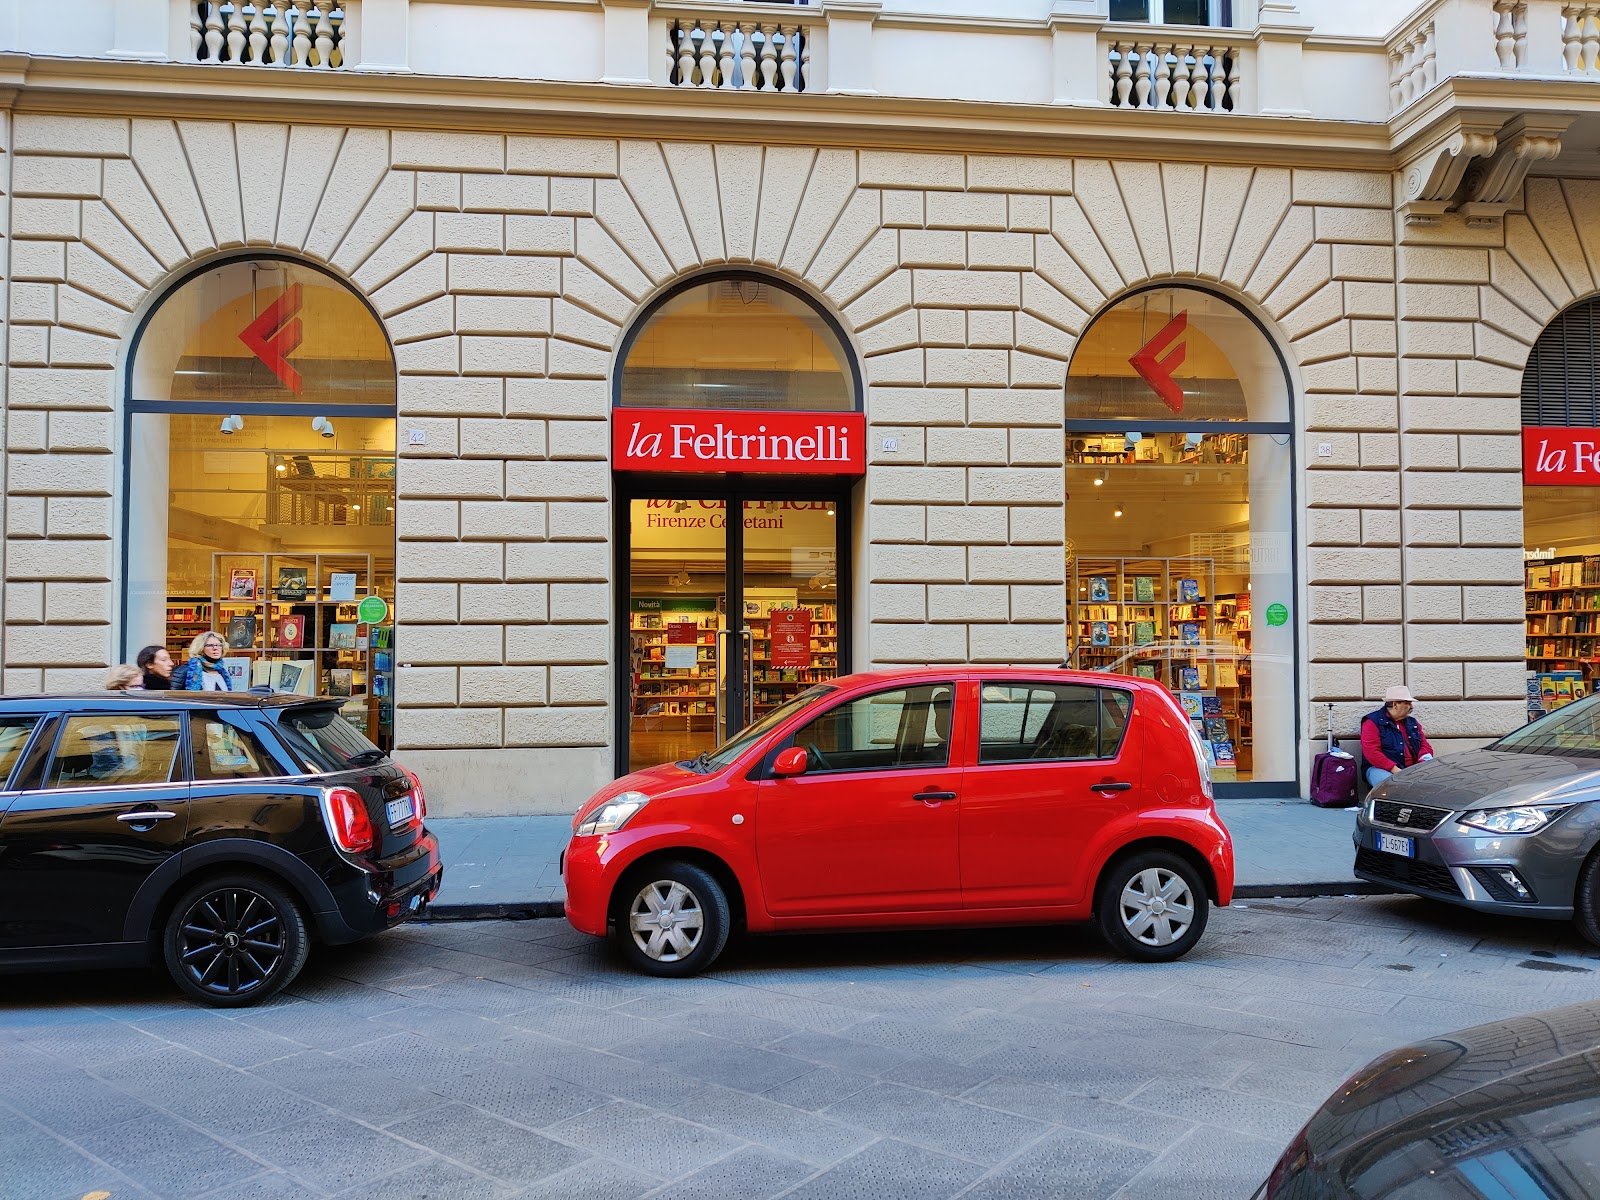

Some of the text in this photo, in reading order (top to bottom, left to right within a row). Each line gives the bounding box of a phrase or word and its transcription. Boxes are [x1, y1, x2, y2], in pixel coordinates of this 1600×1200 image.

[410, 432, 424, 443] 42
[626, 421, 851, 462] la Feltrinelli
[883, 440, 897, 450] 40
[1320, 445, 1331, 455] 38
[1536, 439, 1567, 473] la
[646, 513, 784, 530] Firenze Ceetani
[638, 600, 660, 609] Novità
